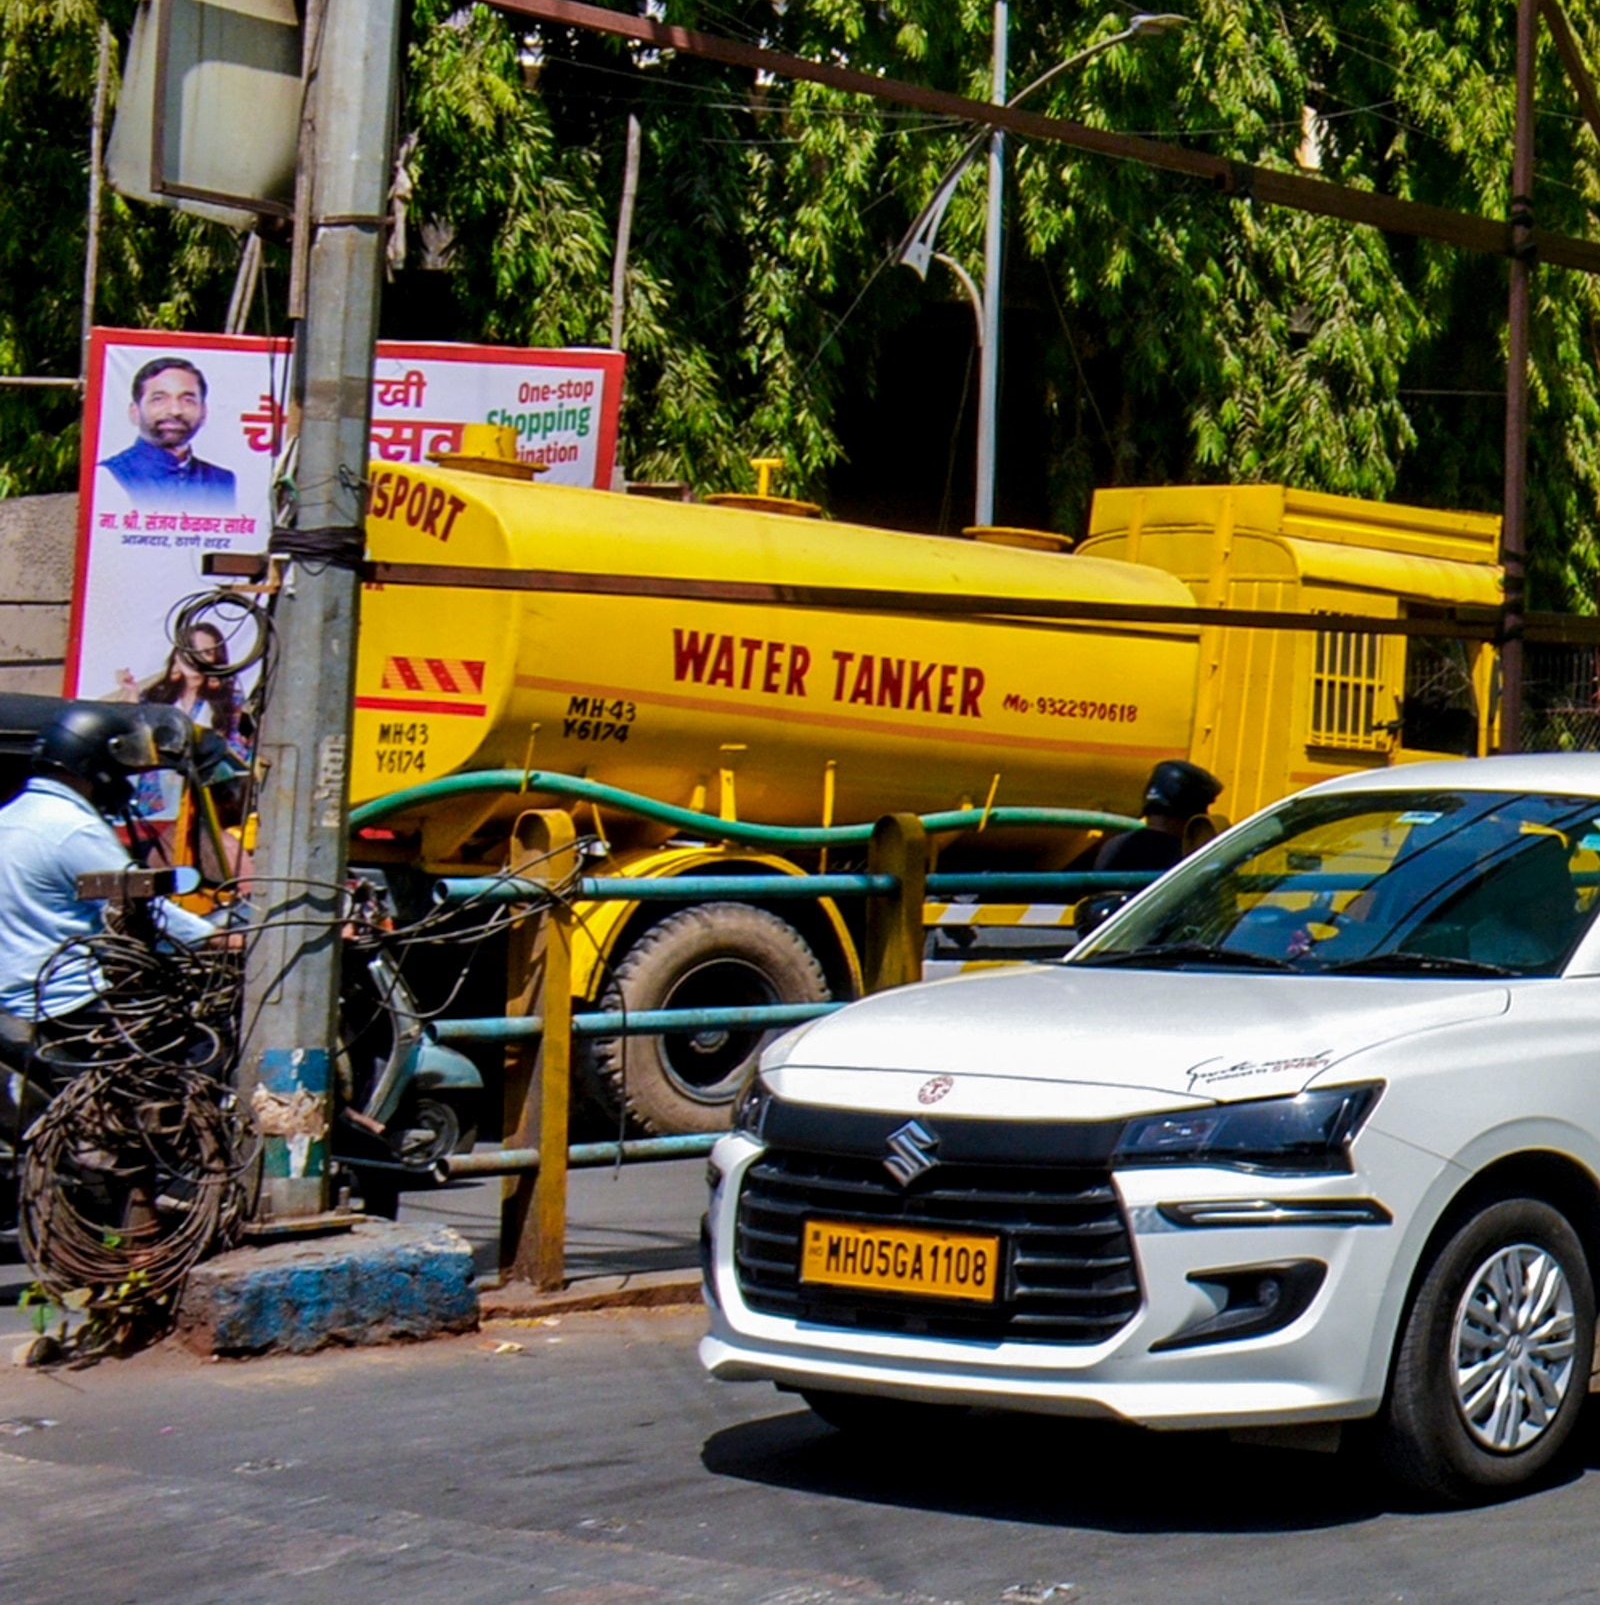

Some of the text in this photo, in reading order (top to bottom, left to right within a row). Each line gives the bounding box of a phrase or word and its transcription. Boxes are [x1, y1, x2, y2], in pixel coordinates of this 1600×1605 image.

[518, 379, 594, 403] One-stop
[487, 402, 591, 441] Shopping
[516, 441, 578, 464] ination
[144, 510, 178, 531] संजय
[673, 628, 811, 698] WATER
[832, 650, 986, 719] TANKER
[825, 1235, 987, 1286] MH05GA1108
